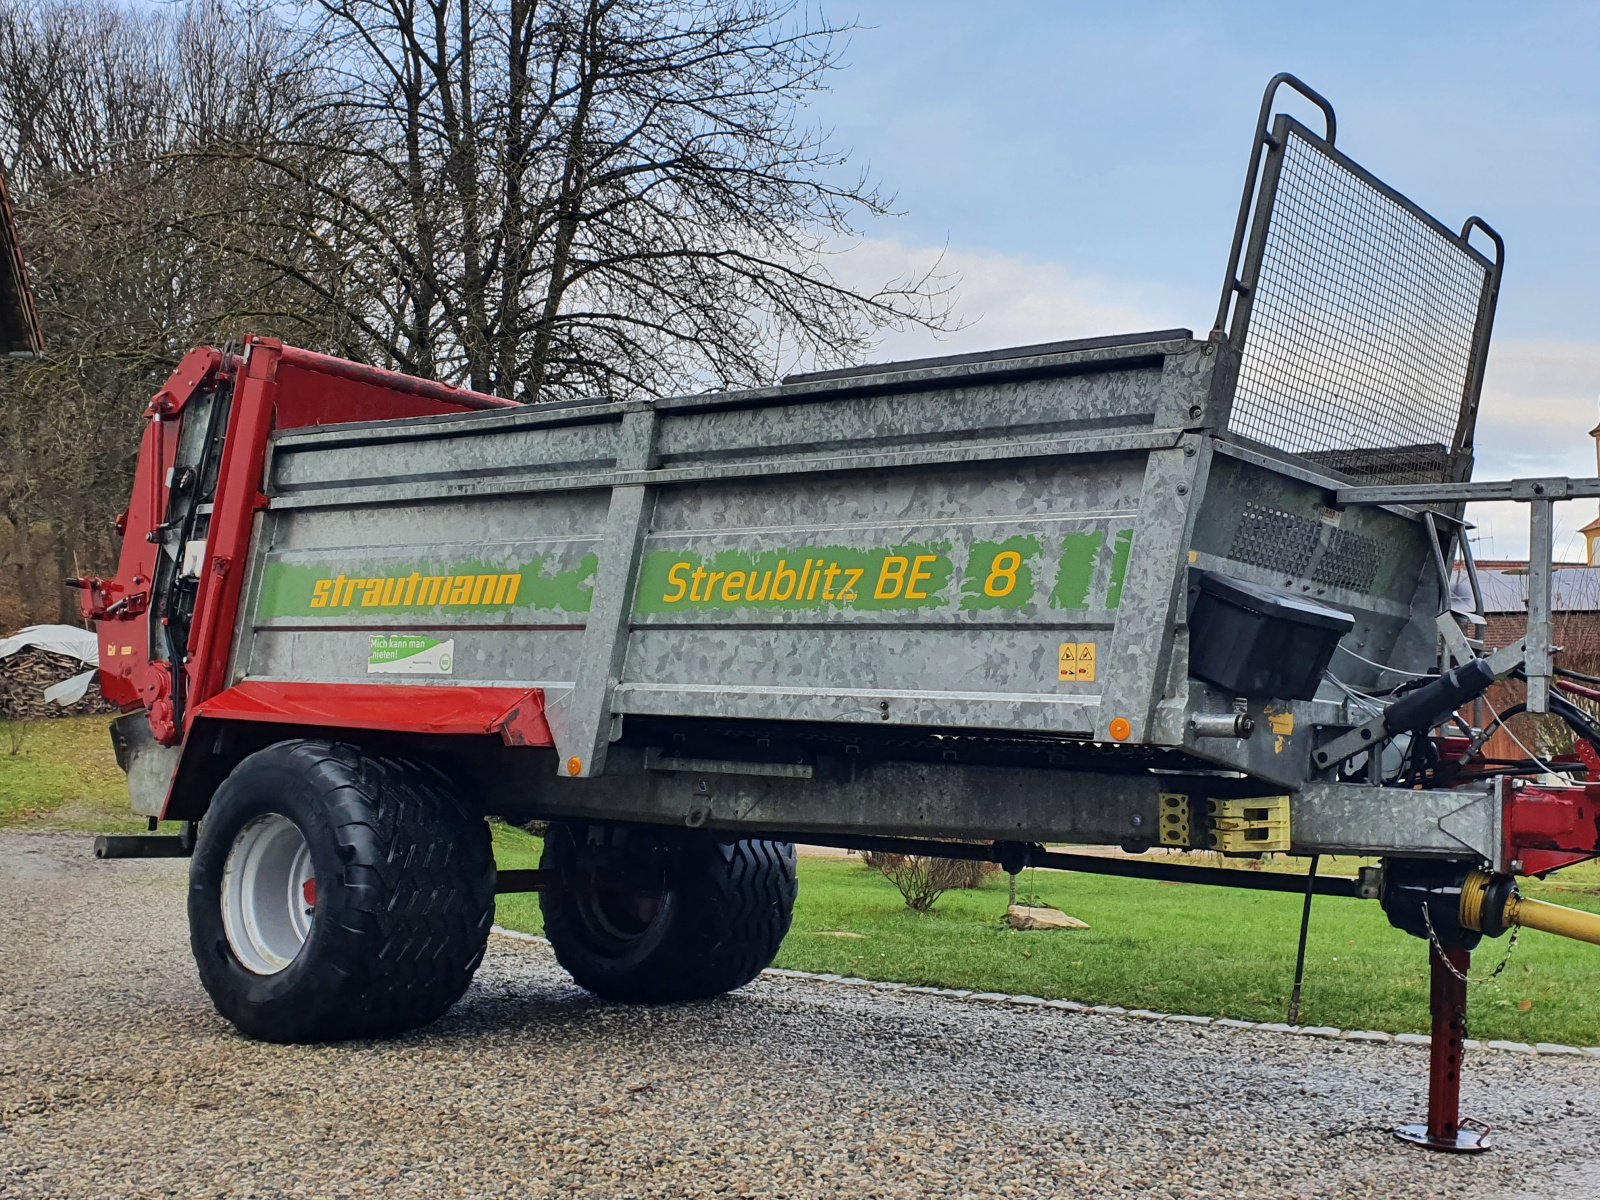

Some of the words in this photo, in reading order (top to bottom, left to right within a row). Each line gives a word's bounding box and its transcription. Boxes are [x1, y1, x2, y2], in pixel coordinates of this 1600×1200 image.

[310, 571, 522, 608] strautmann
[662, 558, 866, 603] Streublitz
[873, 554, 937, 600] BE
[983, 551, 1021, 598] 8
[370, 638, 388, 648] Mich
[389, 638, 407, 648] kann
[408, 640, 425, 648] man
